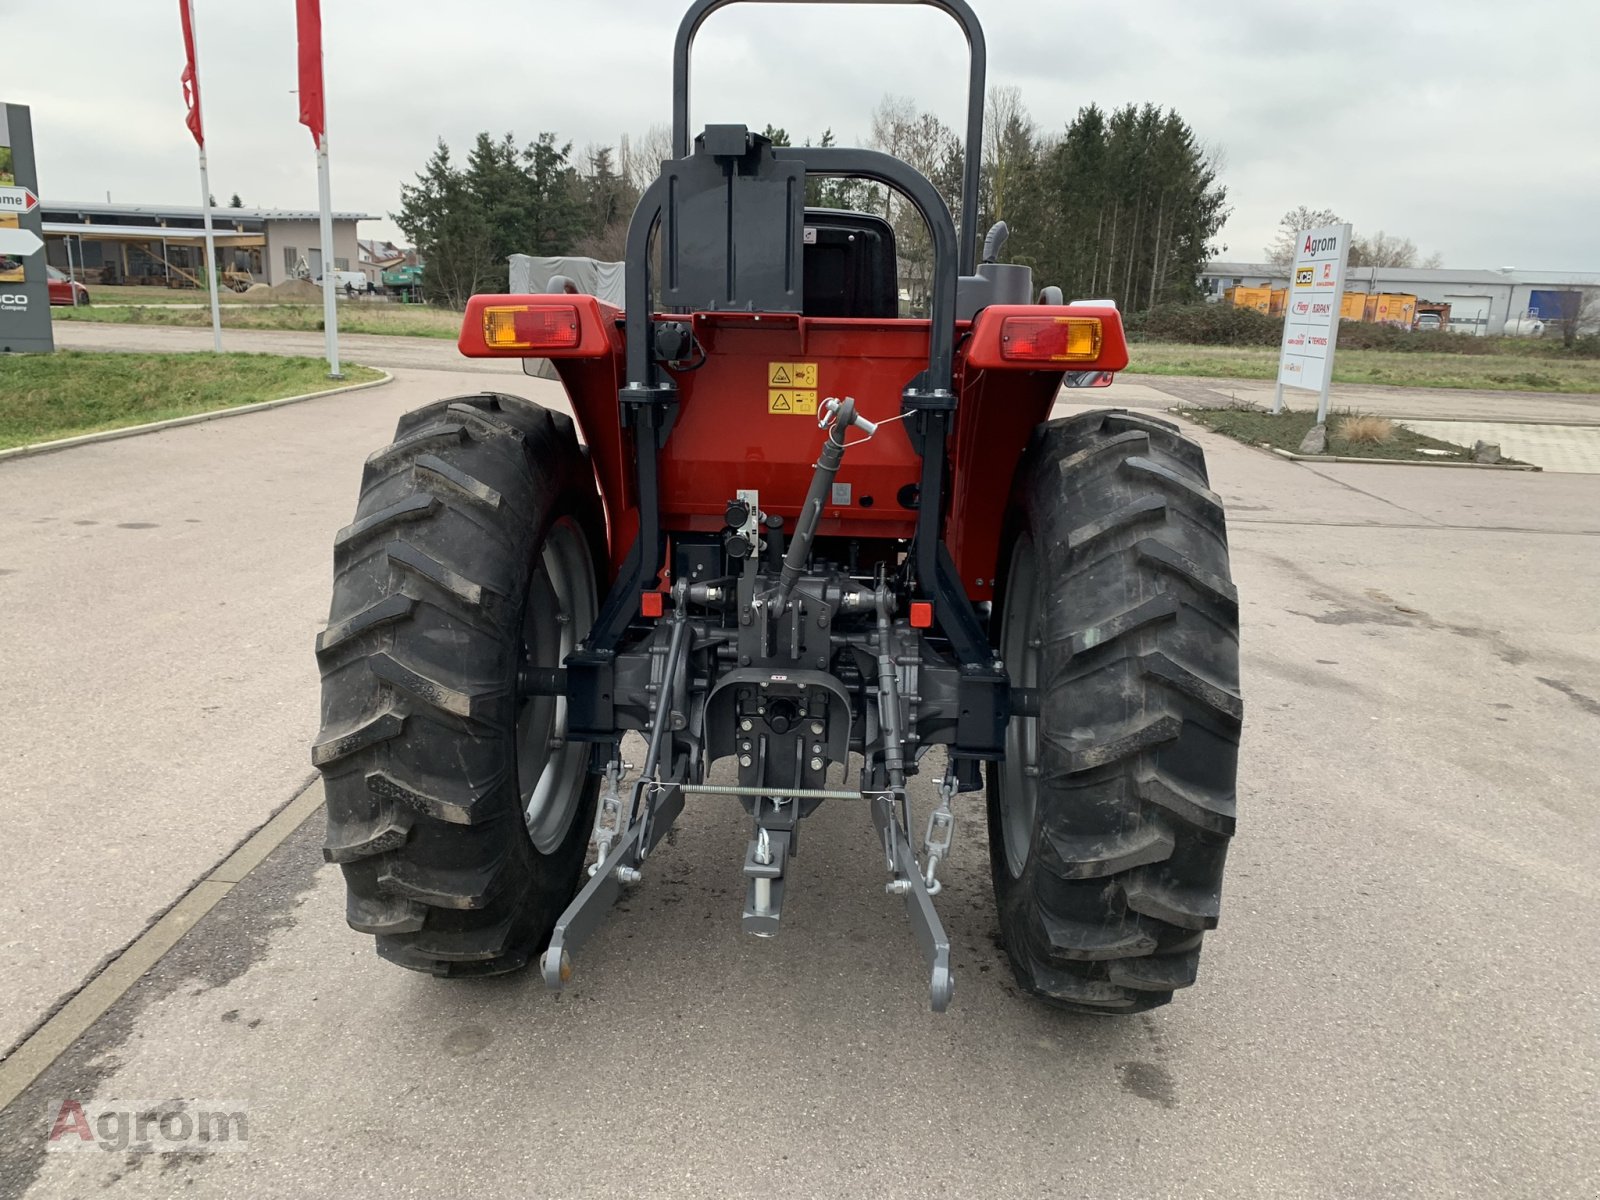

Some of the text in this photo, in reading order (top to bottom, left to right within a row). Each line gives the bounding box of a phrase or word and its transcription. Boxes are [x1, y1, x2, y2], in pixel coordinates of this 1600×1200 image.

[0, 196, 23, 206] me
[1304, 235, 1337, 257] Agrom
[1296, 271, 1313, 284] JCB
[0, 294, 28, 304] CO
